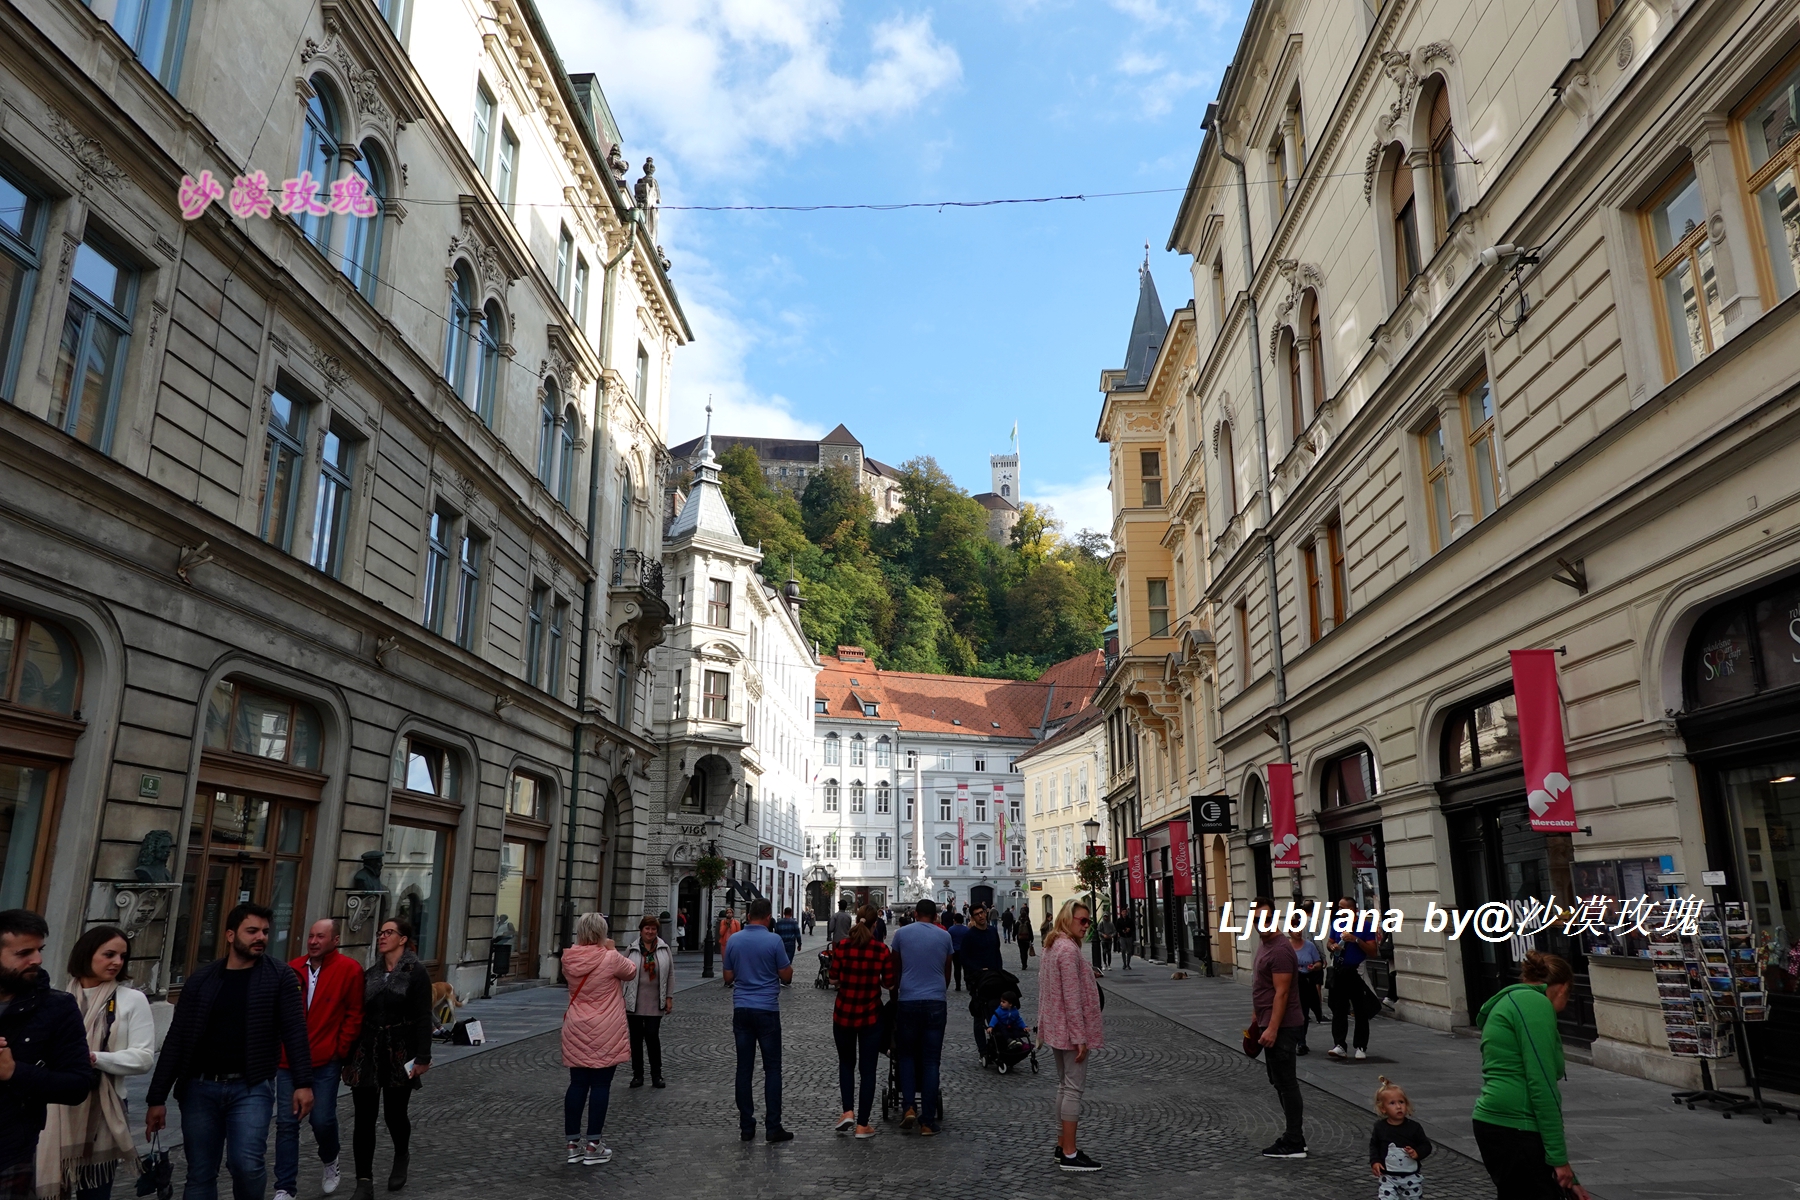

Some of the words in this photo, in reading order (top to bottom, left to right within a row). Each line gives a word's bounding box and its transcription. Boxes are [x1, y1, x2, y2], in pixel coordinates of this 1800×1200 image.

[148, 779, 154, 789] 6
[1131, 854, 1142, 884] s.Oliver
[1175, 841, 1188, 877] s.Oliver
